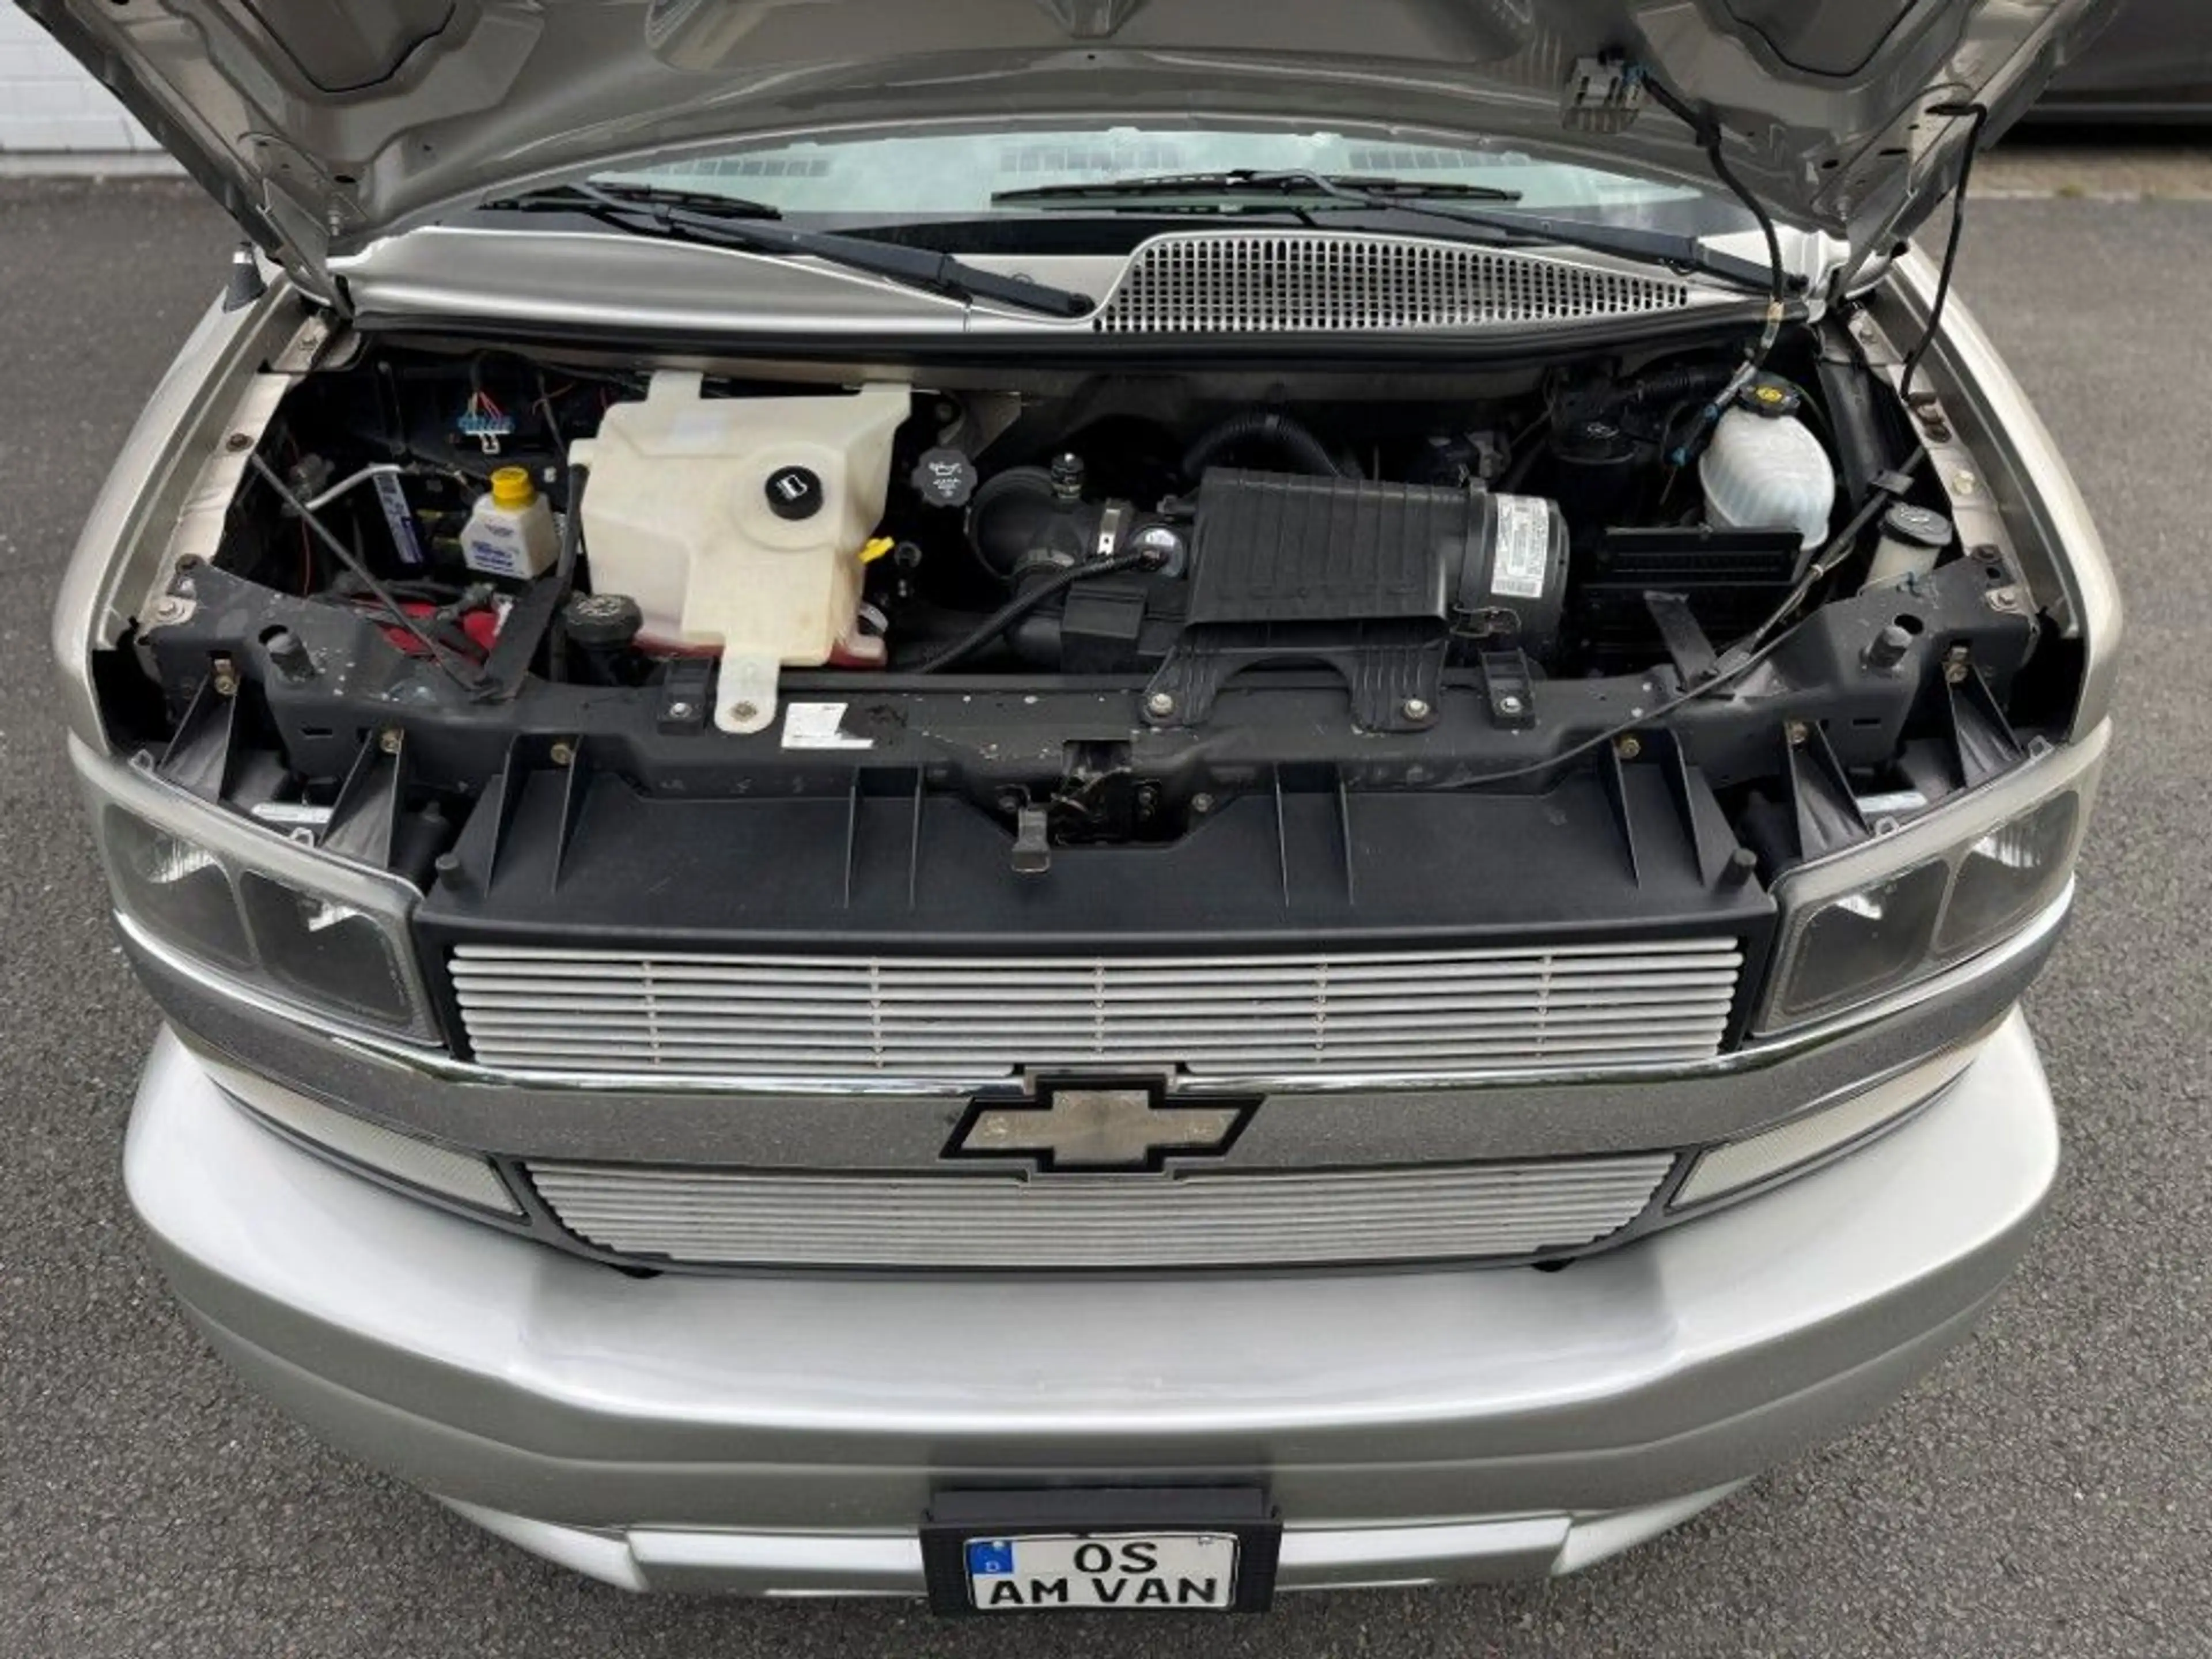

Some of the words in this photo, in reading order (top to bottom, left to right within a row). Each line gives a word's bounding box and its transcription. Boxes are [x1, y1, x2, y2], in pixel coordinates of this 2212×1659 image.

[985, 1560, 1001, 1573] D
[1073, 1541, 1158, 1573] OS
[990, 1578, 1069, 1605] AM
[1092, 1578, 1217, 1604] VAN
